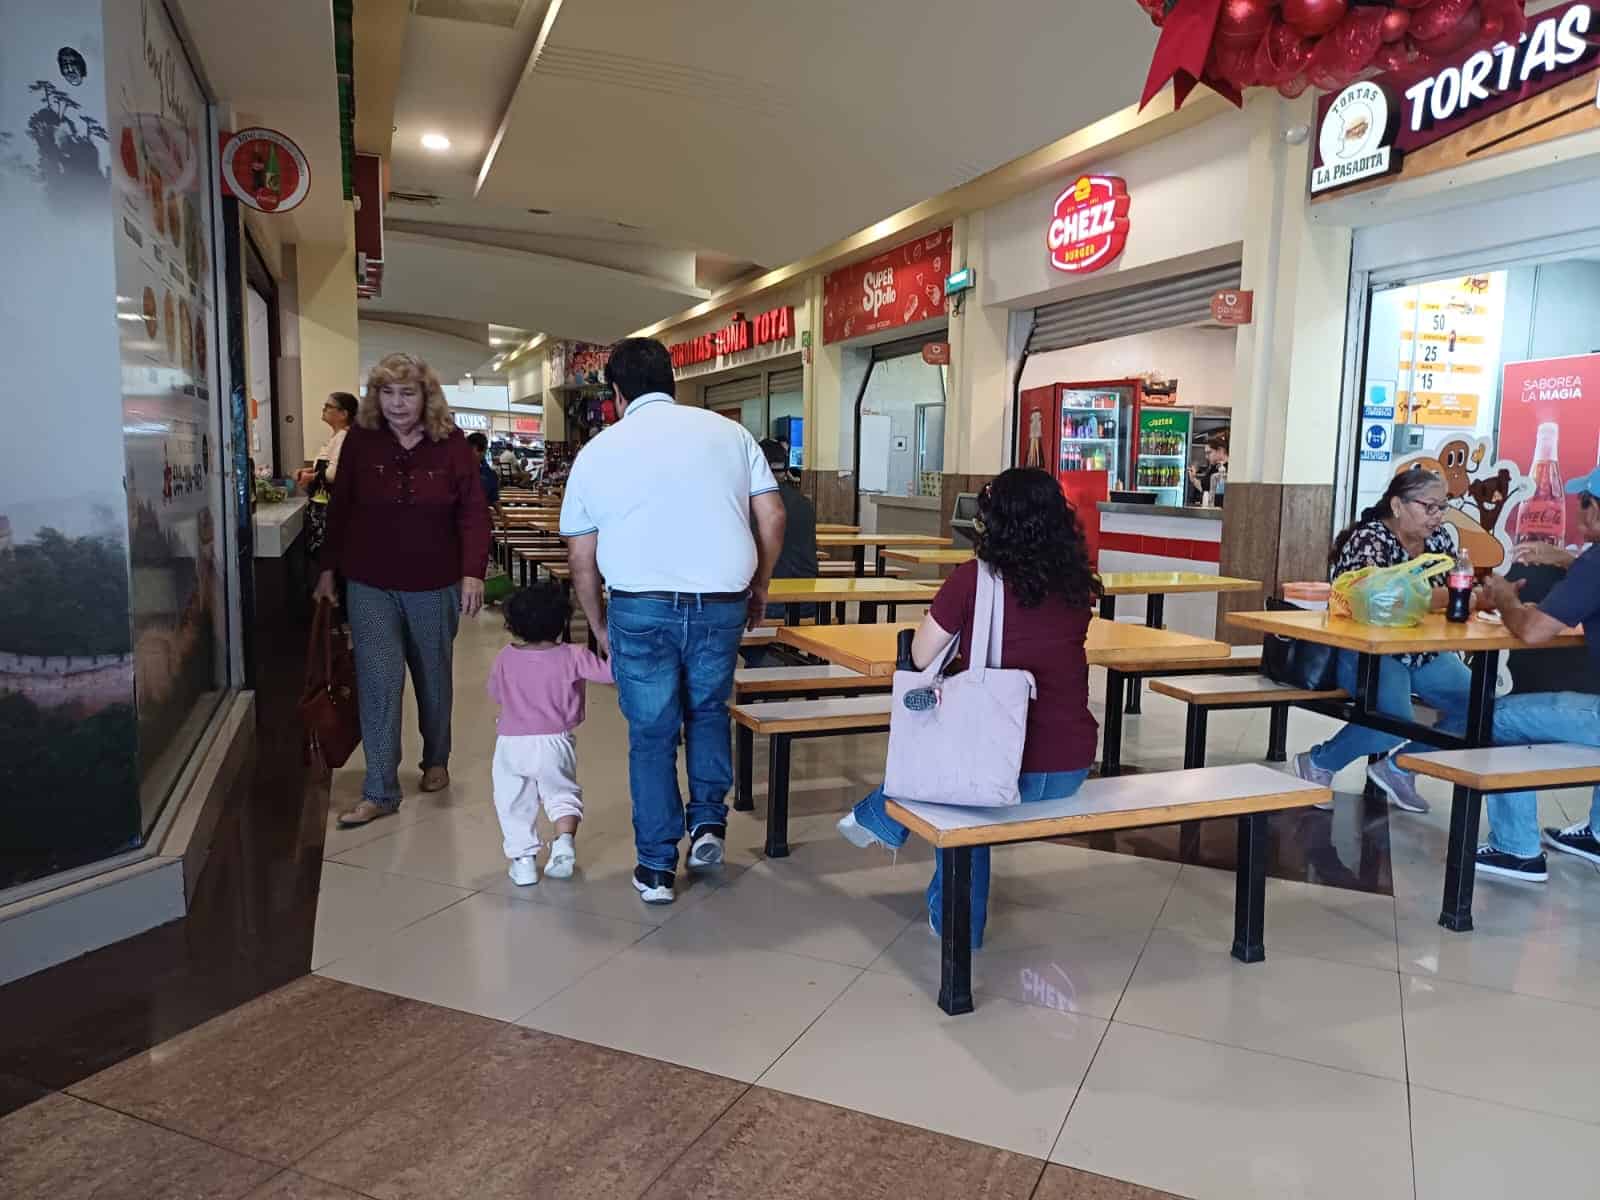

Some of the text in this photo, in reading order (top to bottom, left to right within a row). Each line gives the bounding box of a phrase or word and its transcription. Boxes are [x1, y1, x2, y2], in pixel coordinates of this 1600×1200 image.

[1405, 4, 1591, 131] TORTAS
[1332, 88, 1379, 114] TORTAS
[1316, 152, 1384, 185] LA PASADITA
[1048, 199, 1116, 250] CHEZZ
[1064, 244, 1096, 263] BURGER
[1432, 313, 1446, 331] 50
[669, 332, 713, 369] ORDITAS
[754, 305, 793, 346] TOTA
[1424, 345, 1438, 362] 25
[1421, 373, 1433, 390] 15
[1523, 376, 1583, 392] SABOREA
[1520, 387, 1583, 403] LA MAGIA
